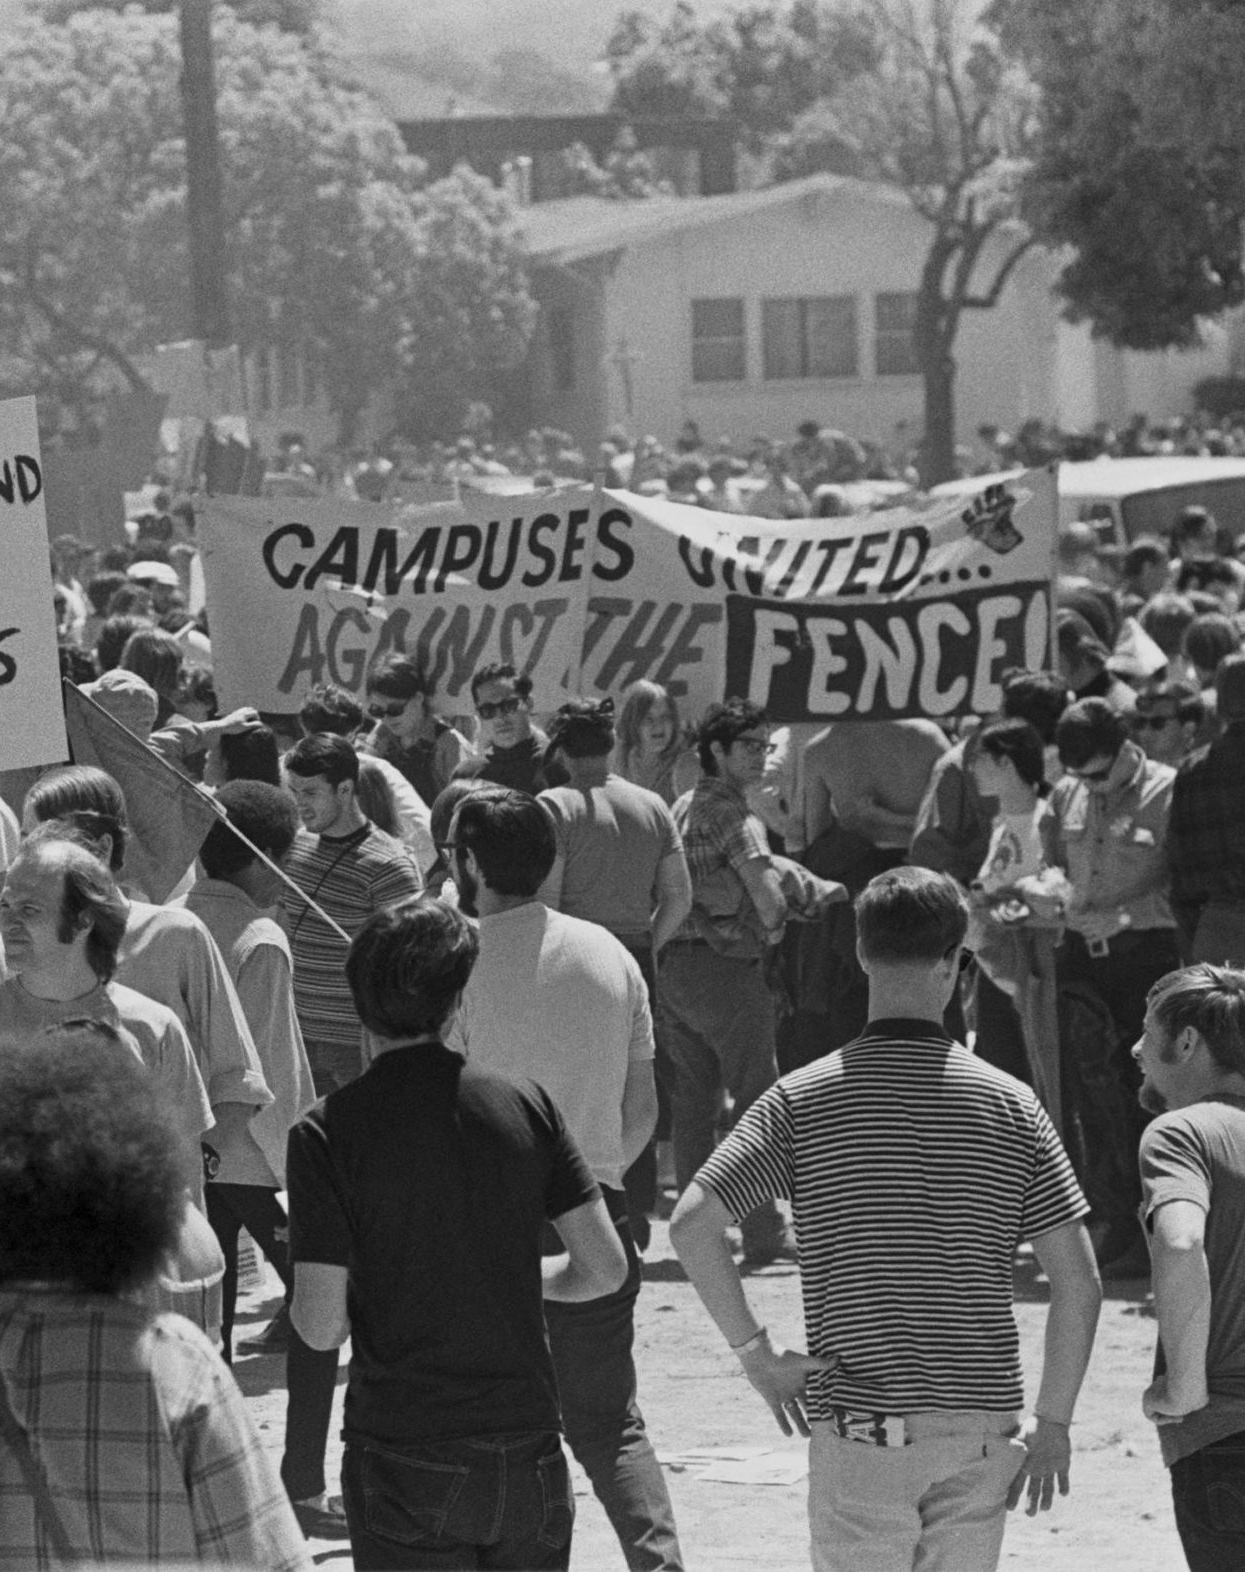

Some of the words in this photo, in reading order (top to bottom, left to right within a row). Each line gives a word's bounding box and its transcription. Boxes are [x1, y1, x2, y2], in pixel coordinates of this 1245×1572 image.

[262, 508, 635, 595] CAMPUSES
[559, 596, 723, 698] THE
[748, 590, 1049, 715] FENCE!
